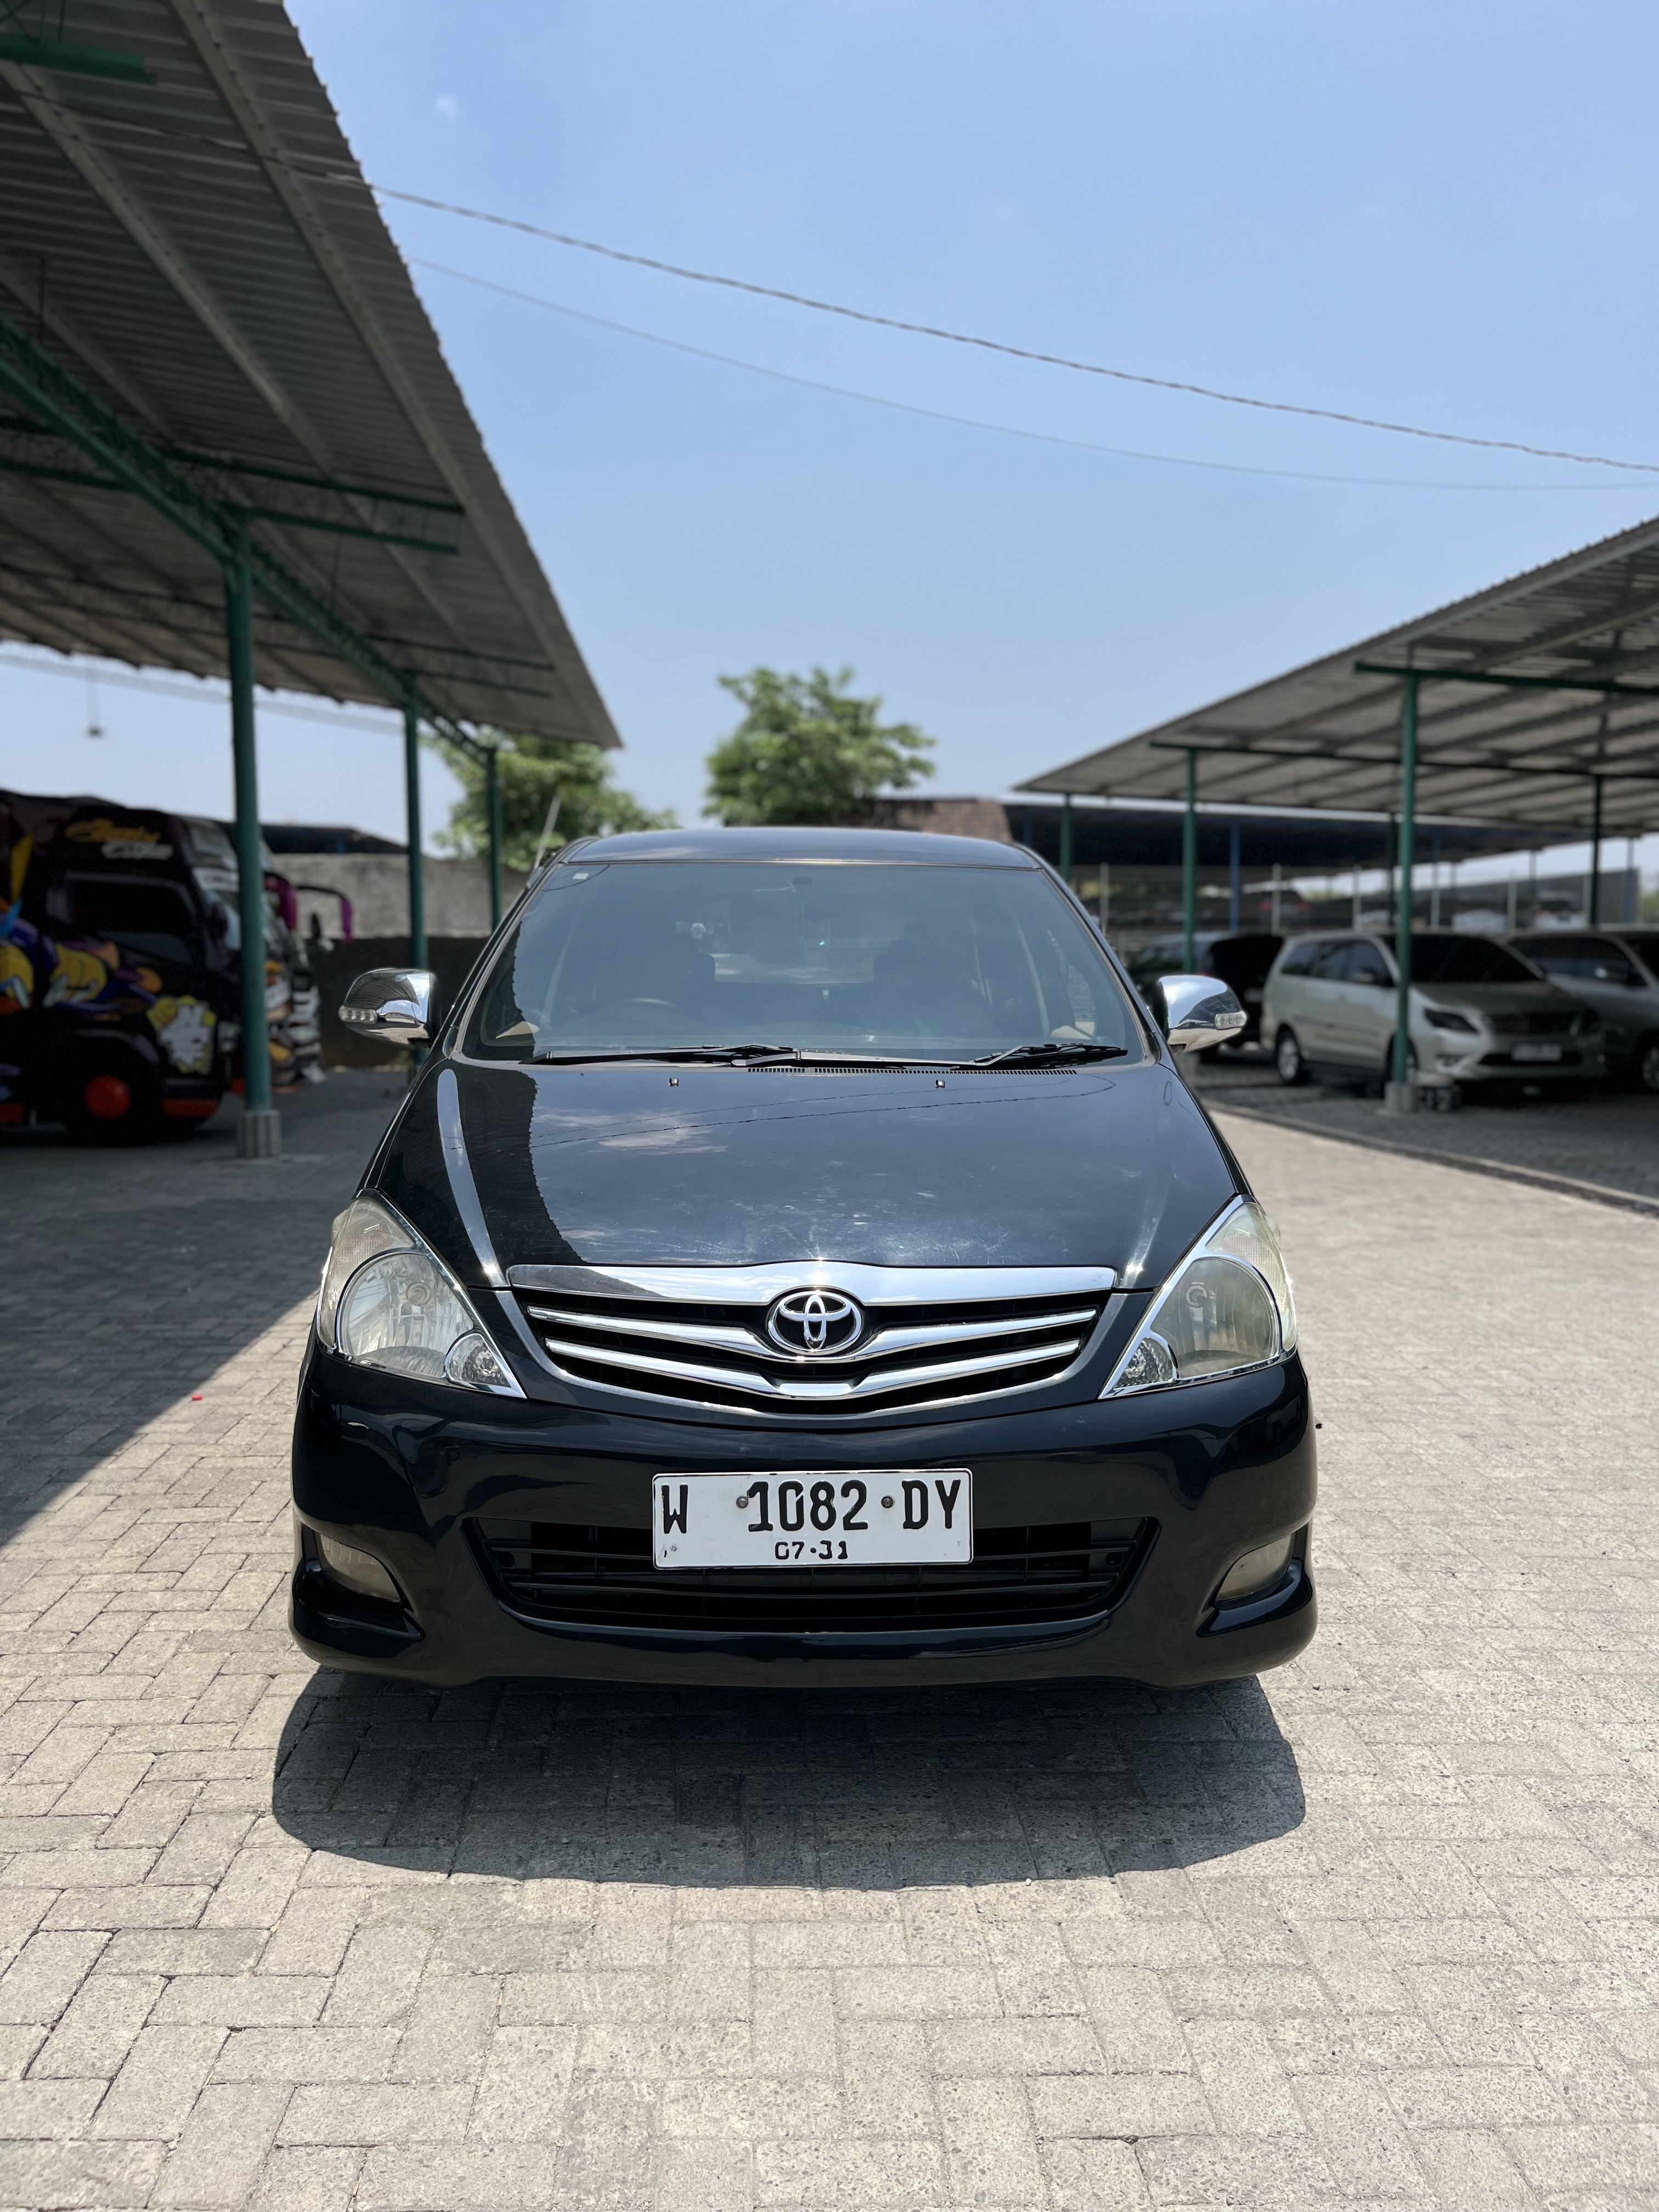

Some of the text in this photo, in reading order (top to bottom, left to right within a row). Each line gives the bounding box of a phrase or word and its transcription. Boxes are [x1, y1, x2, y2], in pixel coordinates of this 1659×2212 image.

[661, 1479, 961, 1534] W 1082 DY
